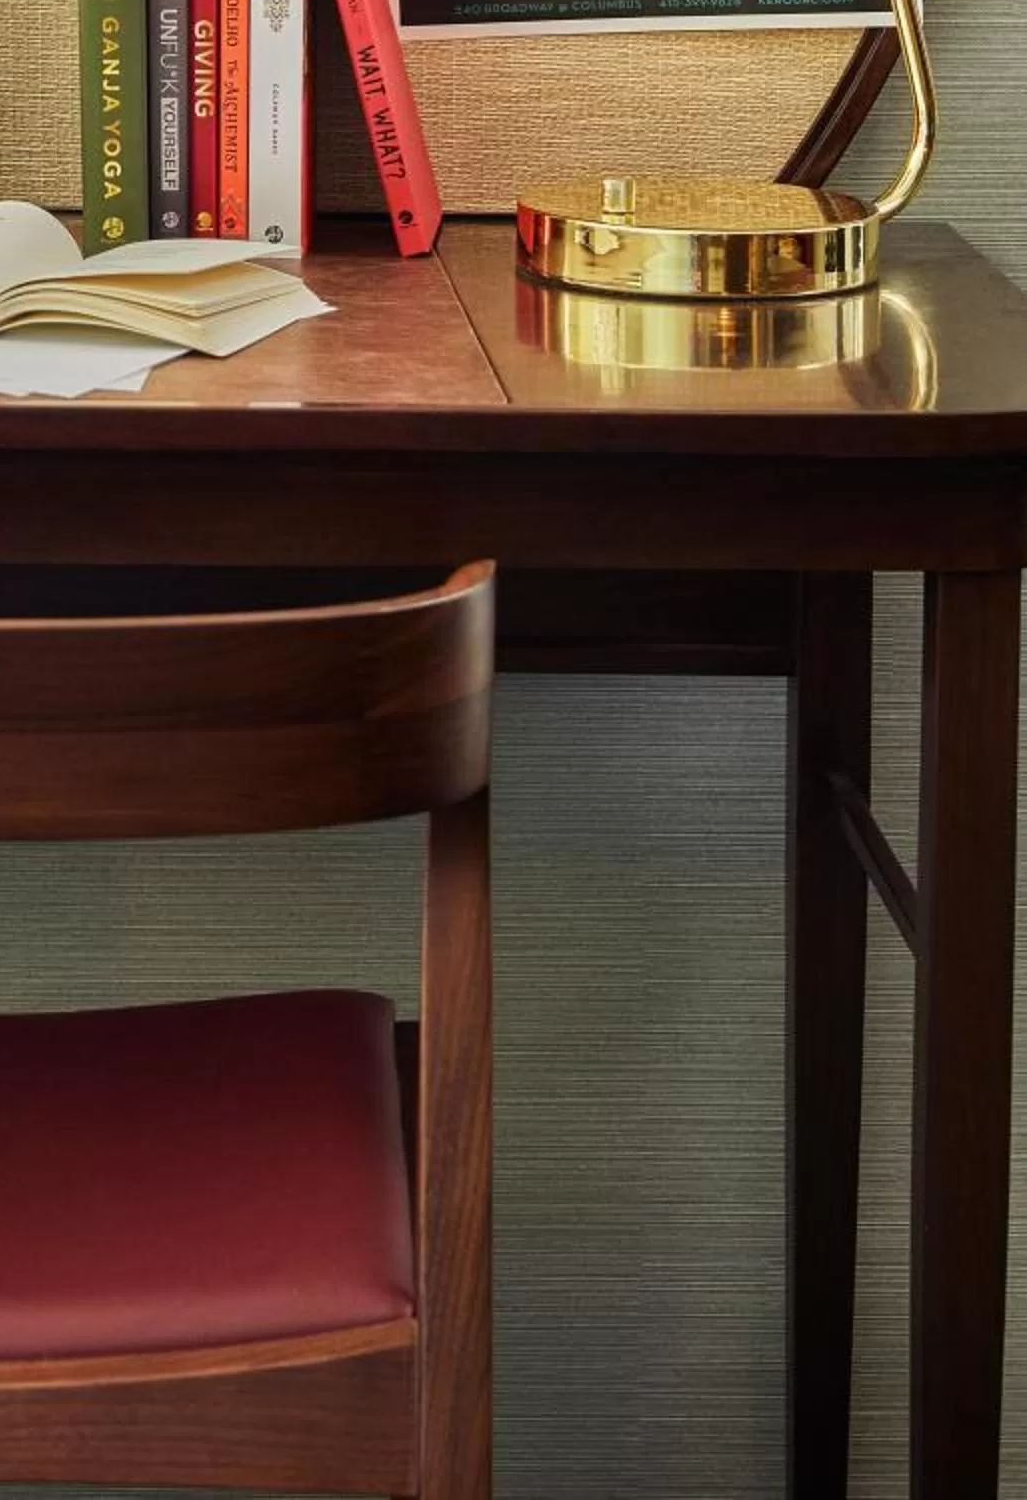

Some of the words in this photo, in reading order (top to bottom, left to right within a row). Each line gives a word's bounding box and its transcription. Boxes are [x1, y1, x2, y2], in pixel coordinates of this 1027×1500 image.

[102, 17, 121, 113] GANJA
[194, 19, 214, 118] GIVING
[102, 122, 123, 199] YOGA
[162, 99, 179, 191] YOURSELF
[372, 107, 406, 179] WHAT?
